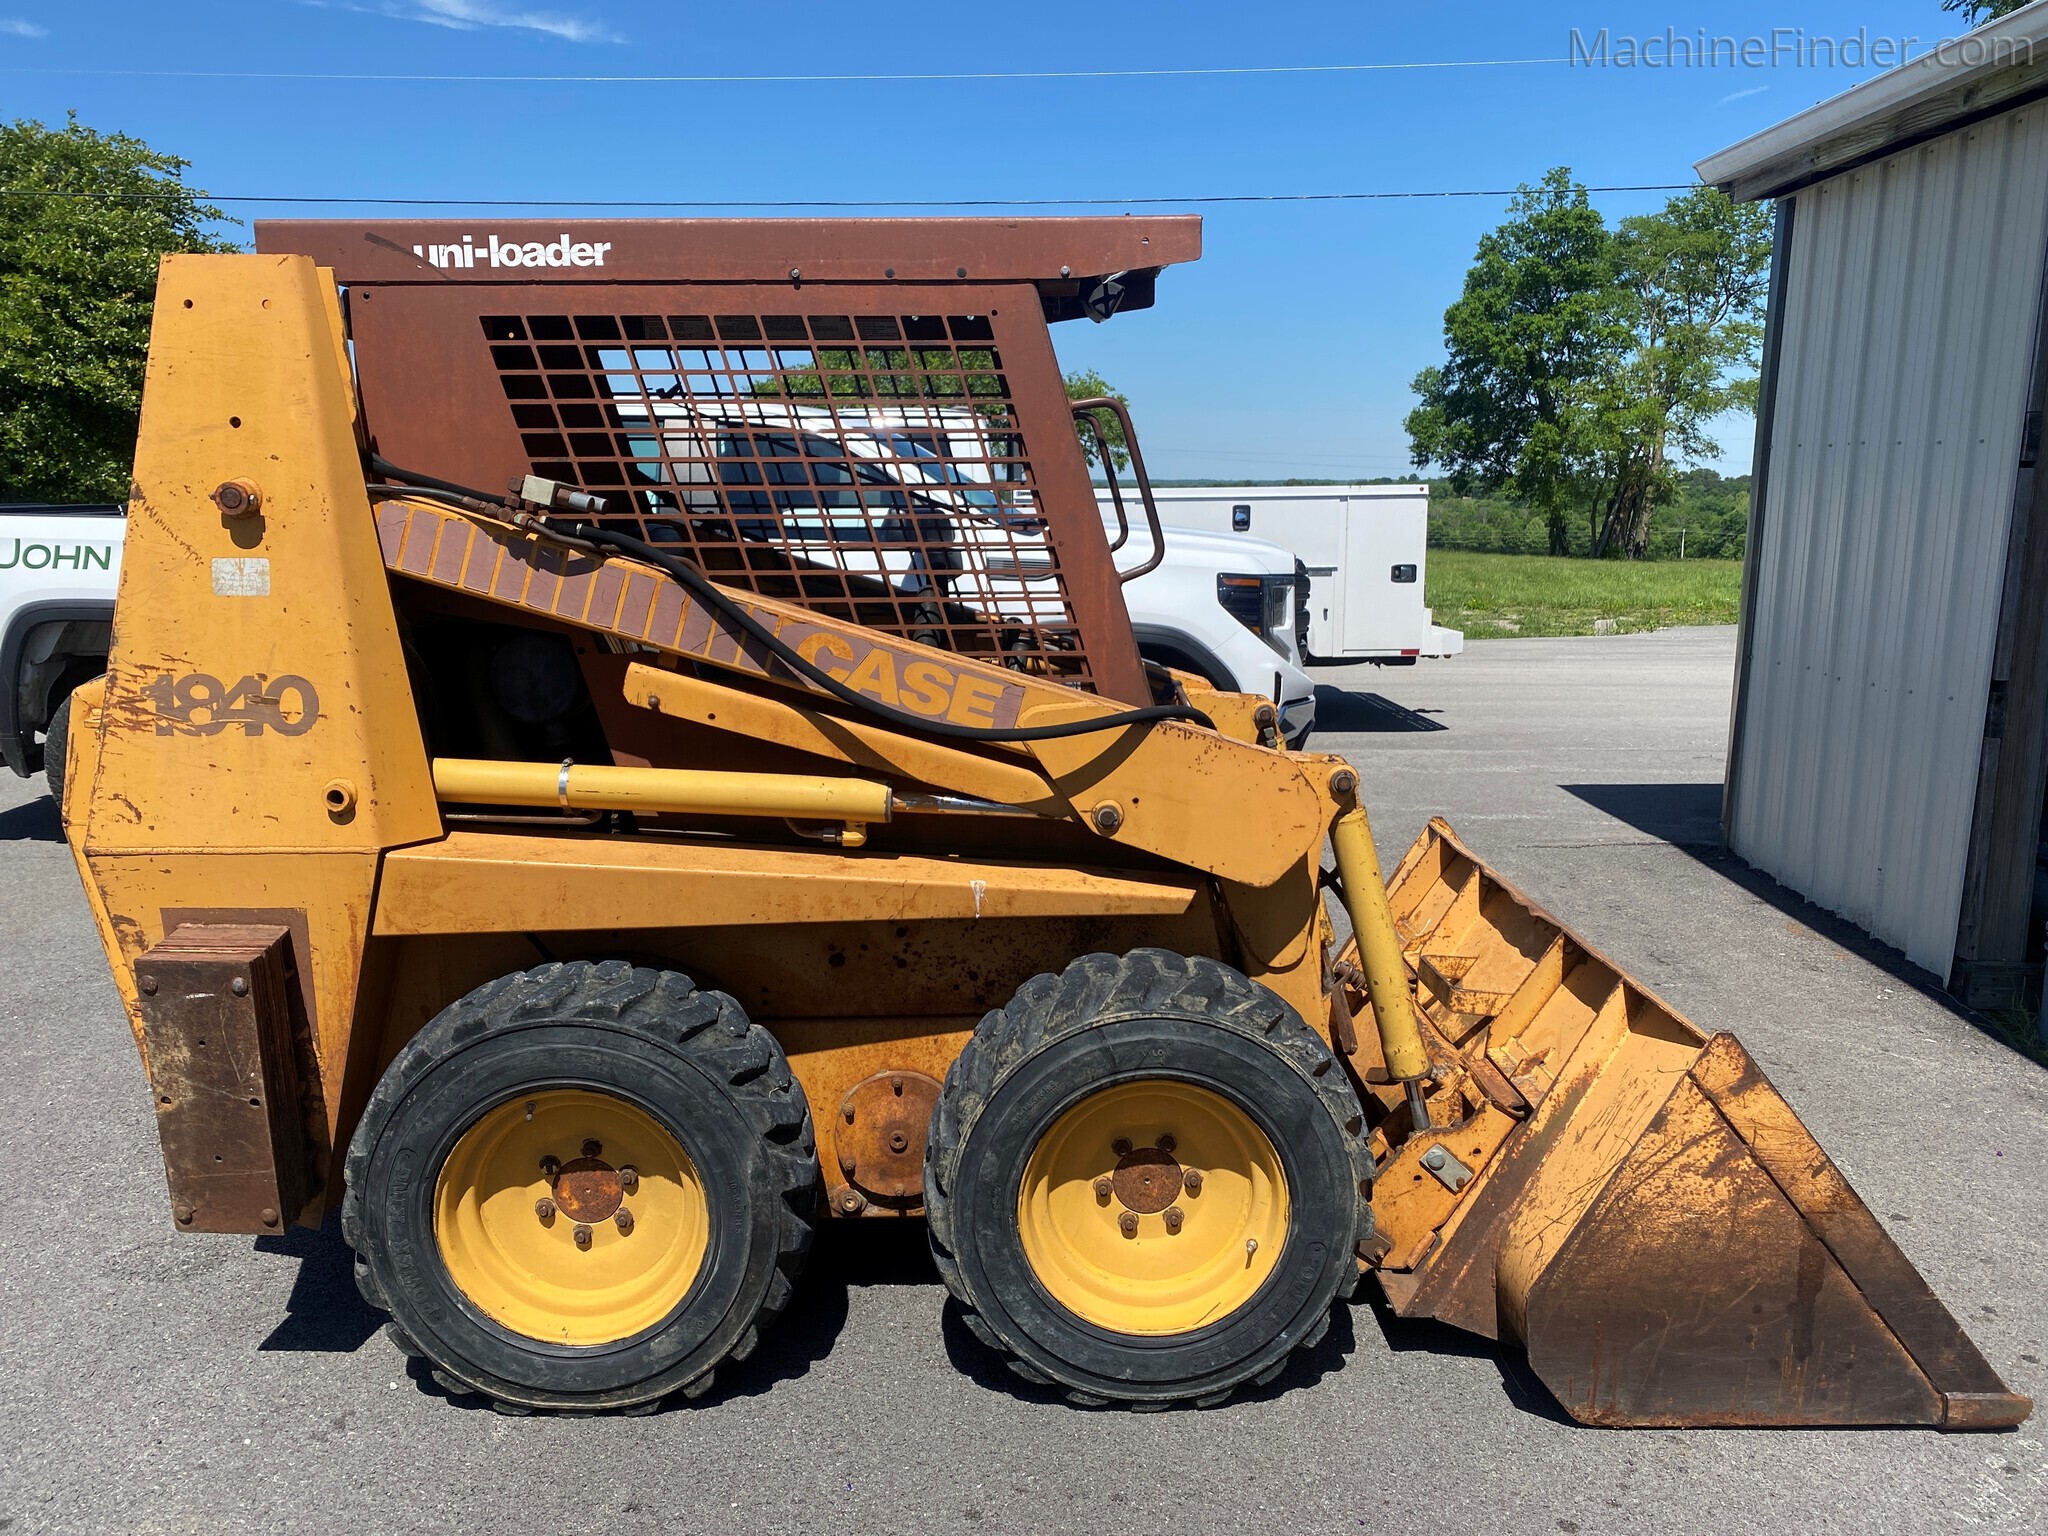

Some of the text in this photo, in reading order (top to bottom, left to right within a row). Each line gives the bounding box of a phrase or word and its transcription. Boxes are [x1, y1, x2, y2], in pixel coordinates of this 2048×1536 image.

[412, 233, 611, 268] uni-loader
[0, 538, 112, 570] JOHN
[139, 673, 320, 737] 1840
[797, 632, 1004, 729] CASE
